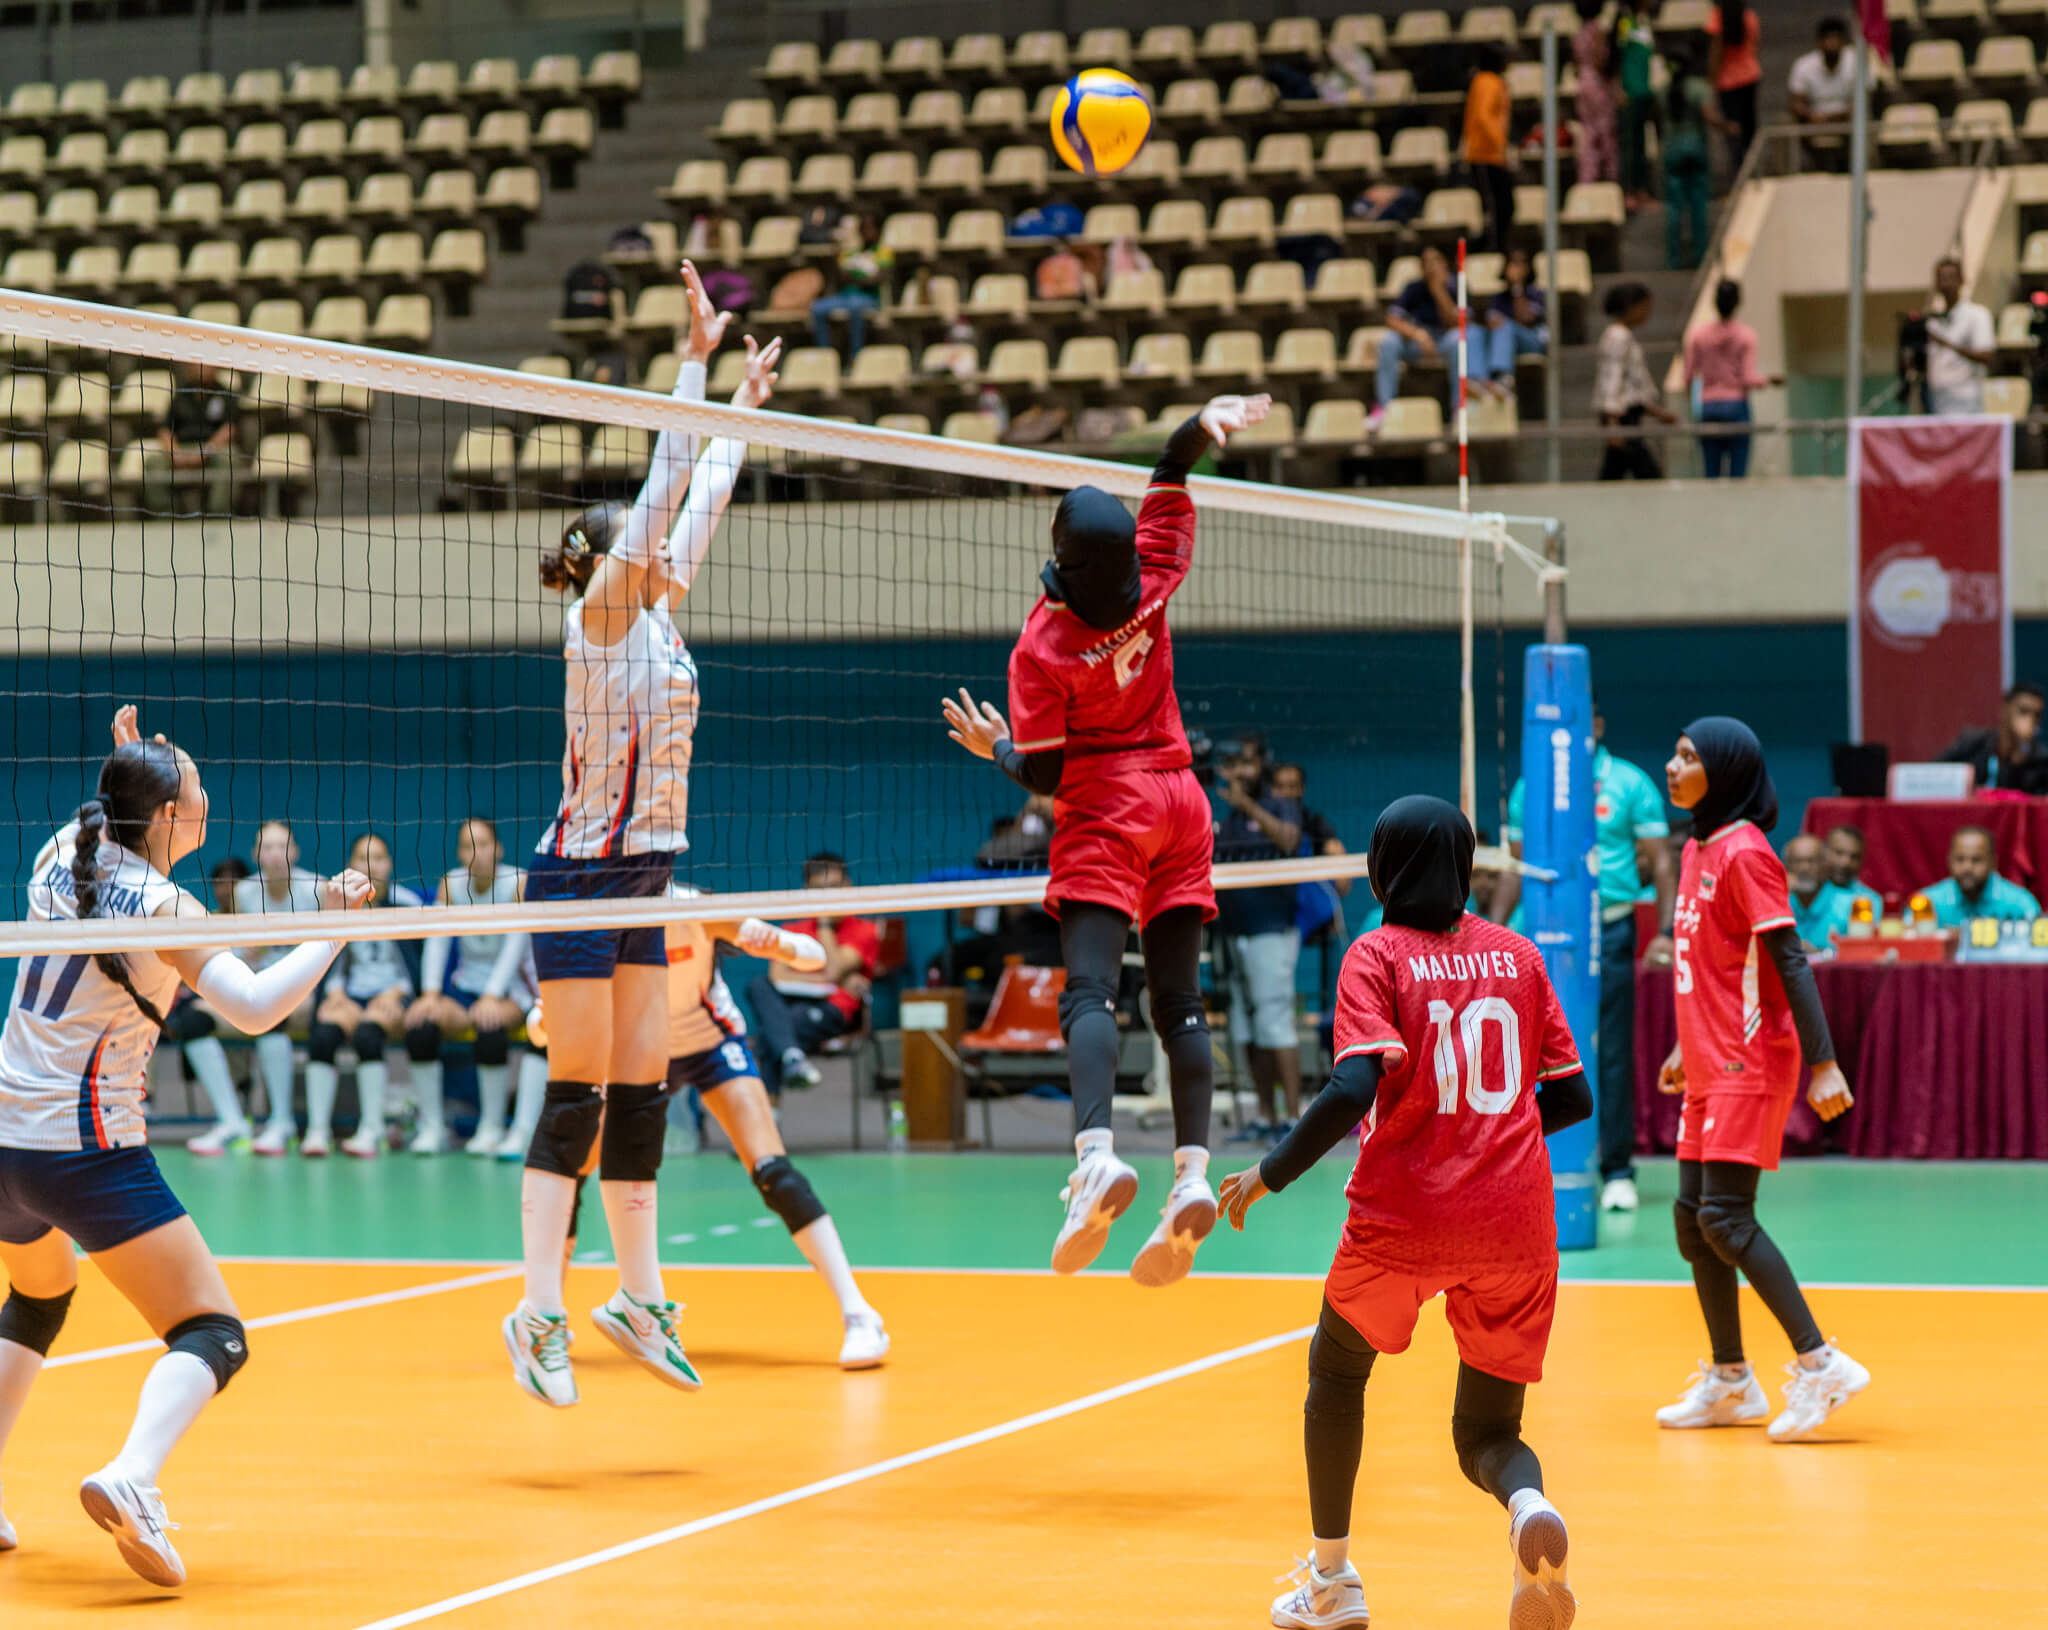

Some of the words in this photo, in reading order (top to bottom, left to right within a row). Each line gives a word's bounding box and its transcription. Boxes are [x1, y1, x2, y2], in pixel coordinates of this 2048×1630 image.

[1408, 951, 1518, 982] MALDIVES
[1676, 937, 1694, 994] 5
[1427, 996, 1522, 1115] 10
